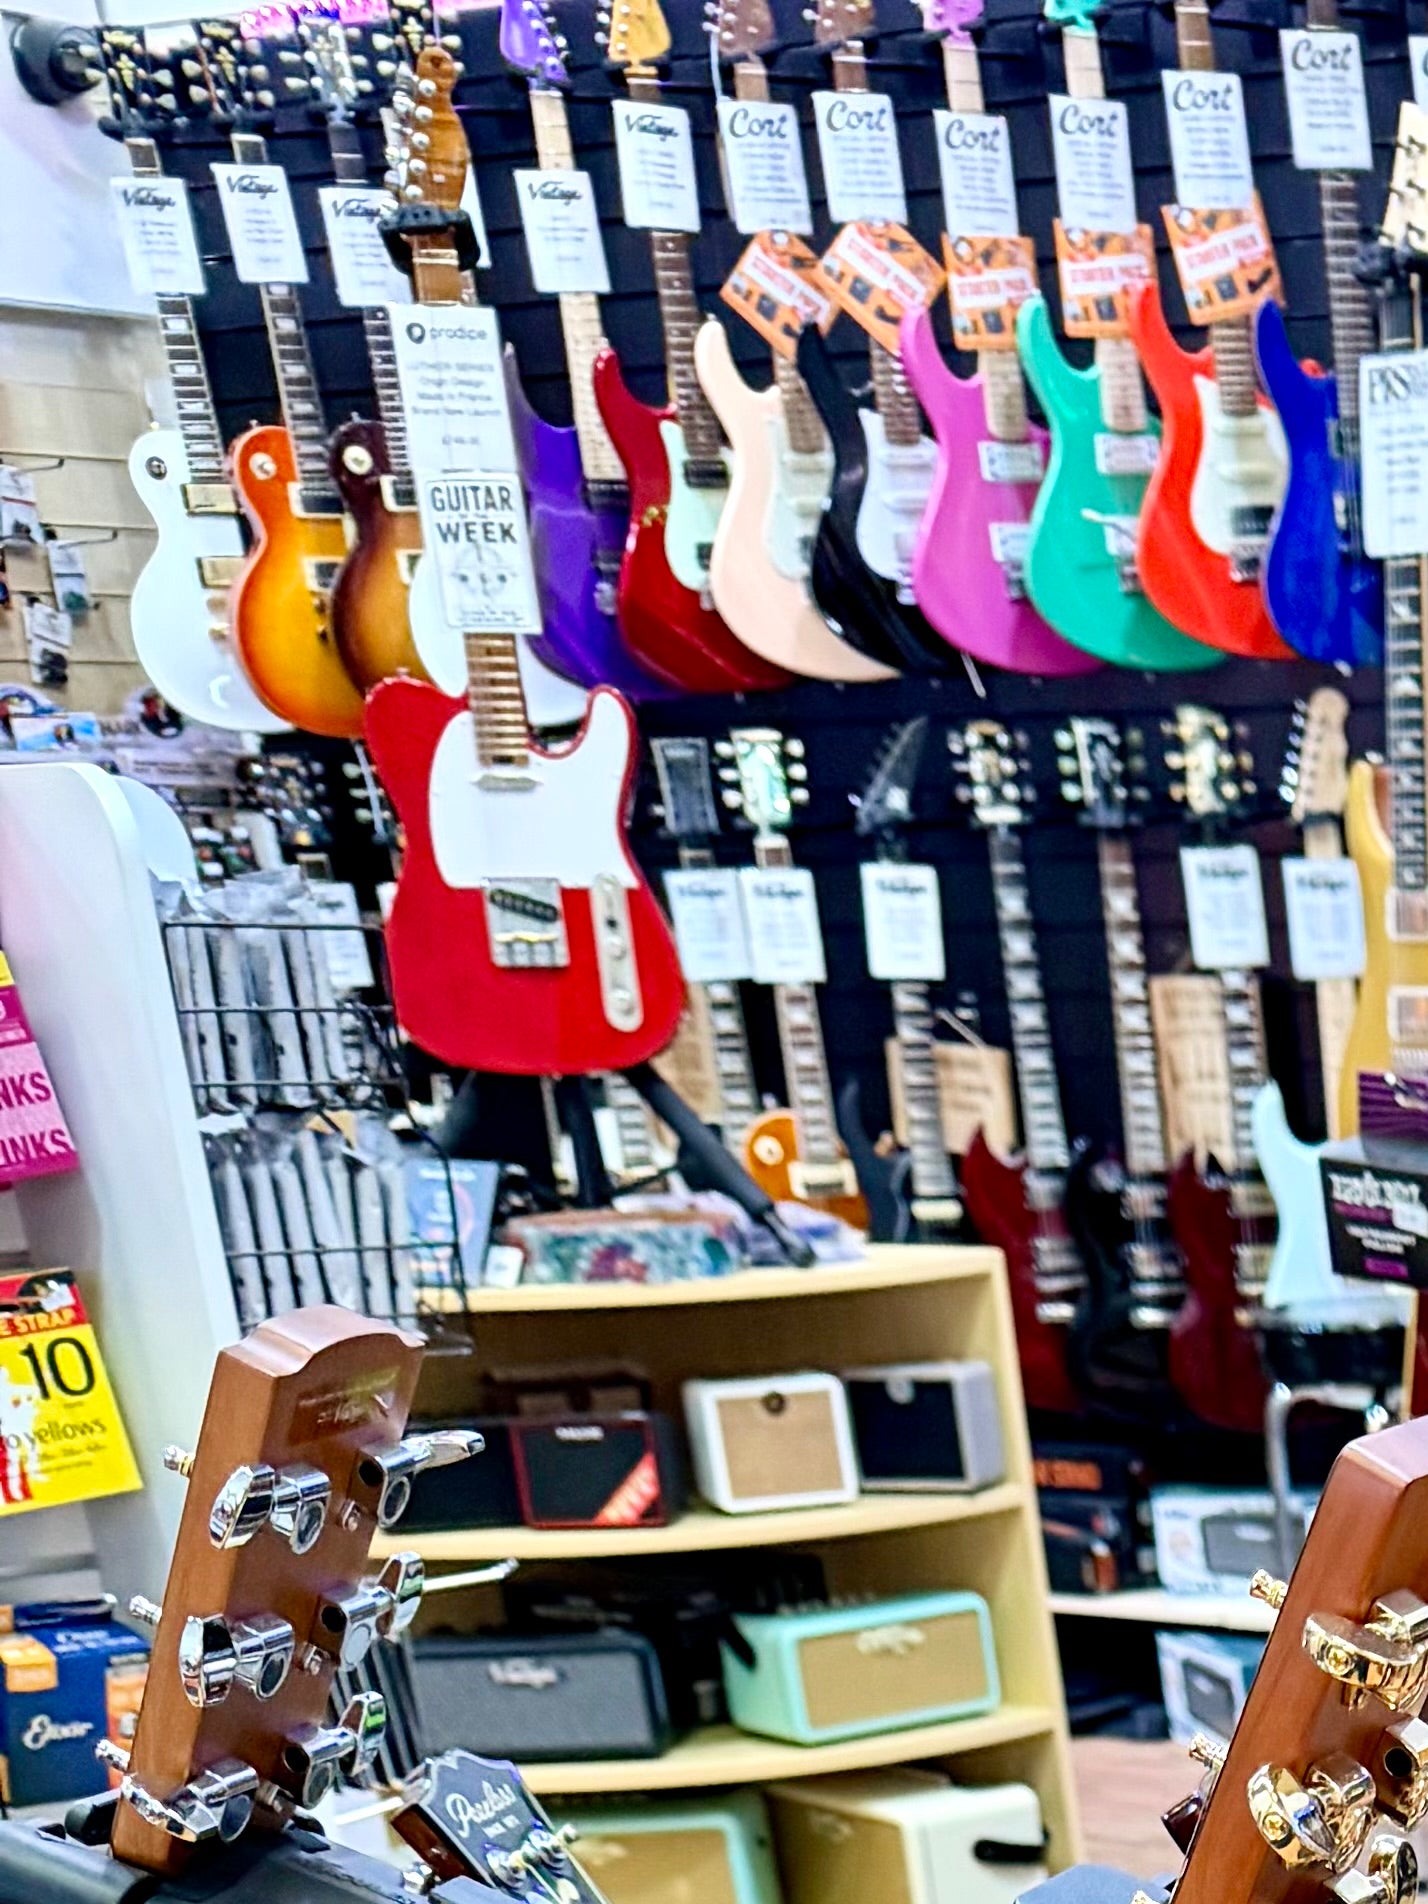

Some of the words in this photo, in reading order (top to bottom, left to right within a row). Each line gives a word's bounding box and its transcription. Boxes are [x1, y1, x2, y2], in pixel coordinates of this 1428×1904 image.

[1291, 39, 1353, 73] Cort
[1173, 79, 1233, 112] Cort
[728, 108, 787, 139] Cort
[825, 100, 886, 132] Cort
[1059, 104, 1119, 137] Cort
[944, 119, 1001, 152] Cort
[226, 174, 279, 199] Vintage
[528, 180, 582, 205] Vintage
[431, 485, 514, 512] GUITAR
[436, 521, 518, 544] WEEK
[0, 1071, 51, 1111] NKS
[0, 1129, 70, 1167] NKS
[15, 1308, 76, 1333] STRAP
[20, 1337, 95, 1400] 10
